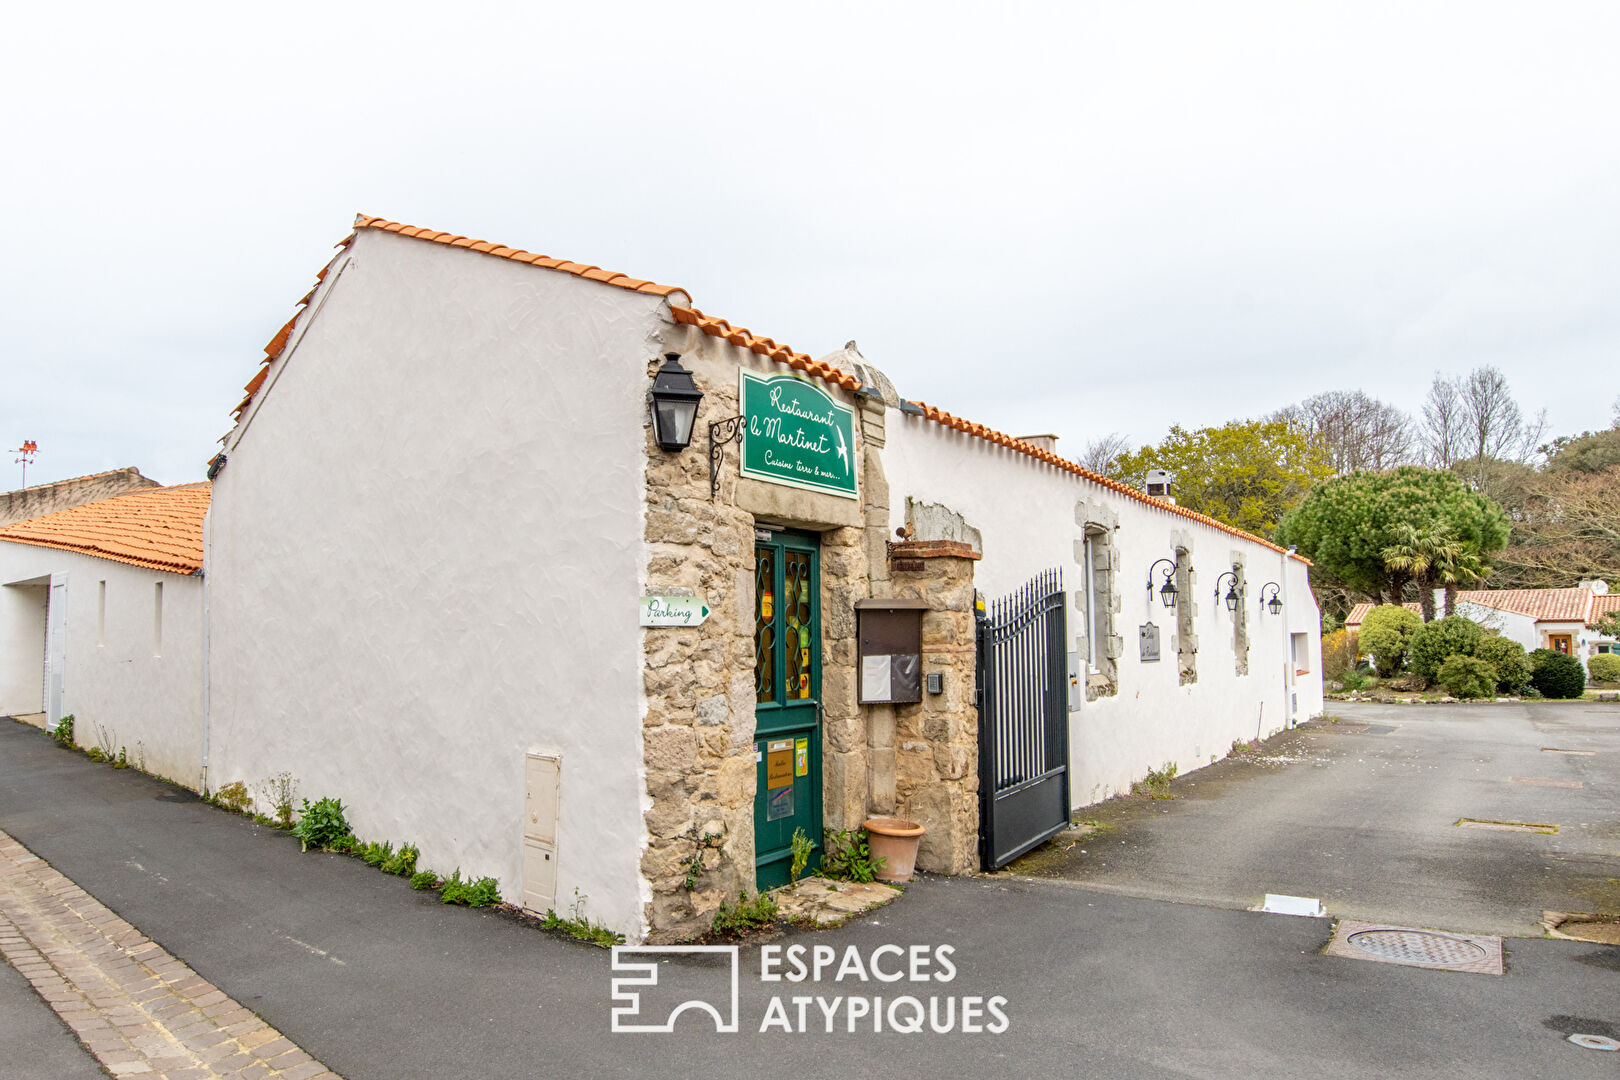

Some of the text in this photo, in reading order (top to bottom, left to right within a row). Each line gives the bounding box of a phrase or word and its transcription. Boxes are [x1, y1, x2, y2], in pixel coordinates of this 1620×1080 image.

[769, 386, 834, 427] Restaurant
[750, 415, 831, 454] le Martinet
[764, 449, 793, 470] Cuisine
[647, 599, 693, 624] Parking
